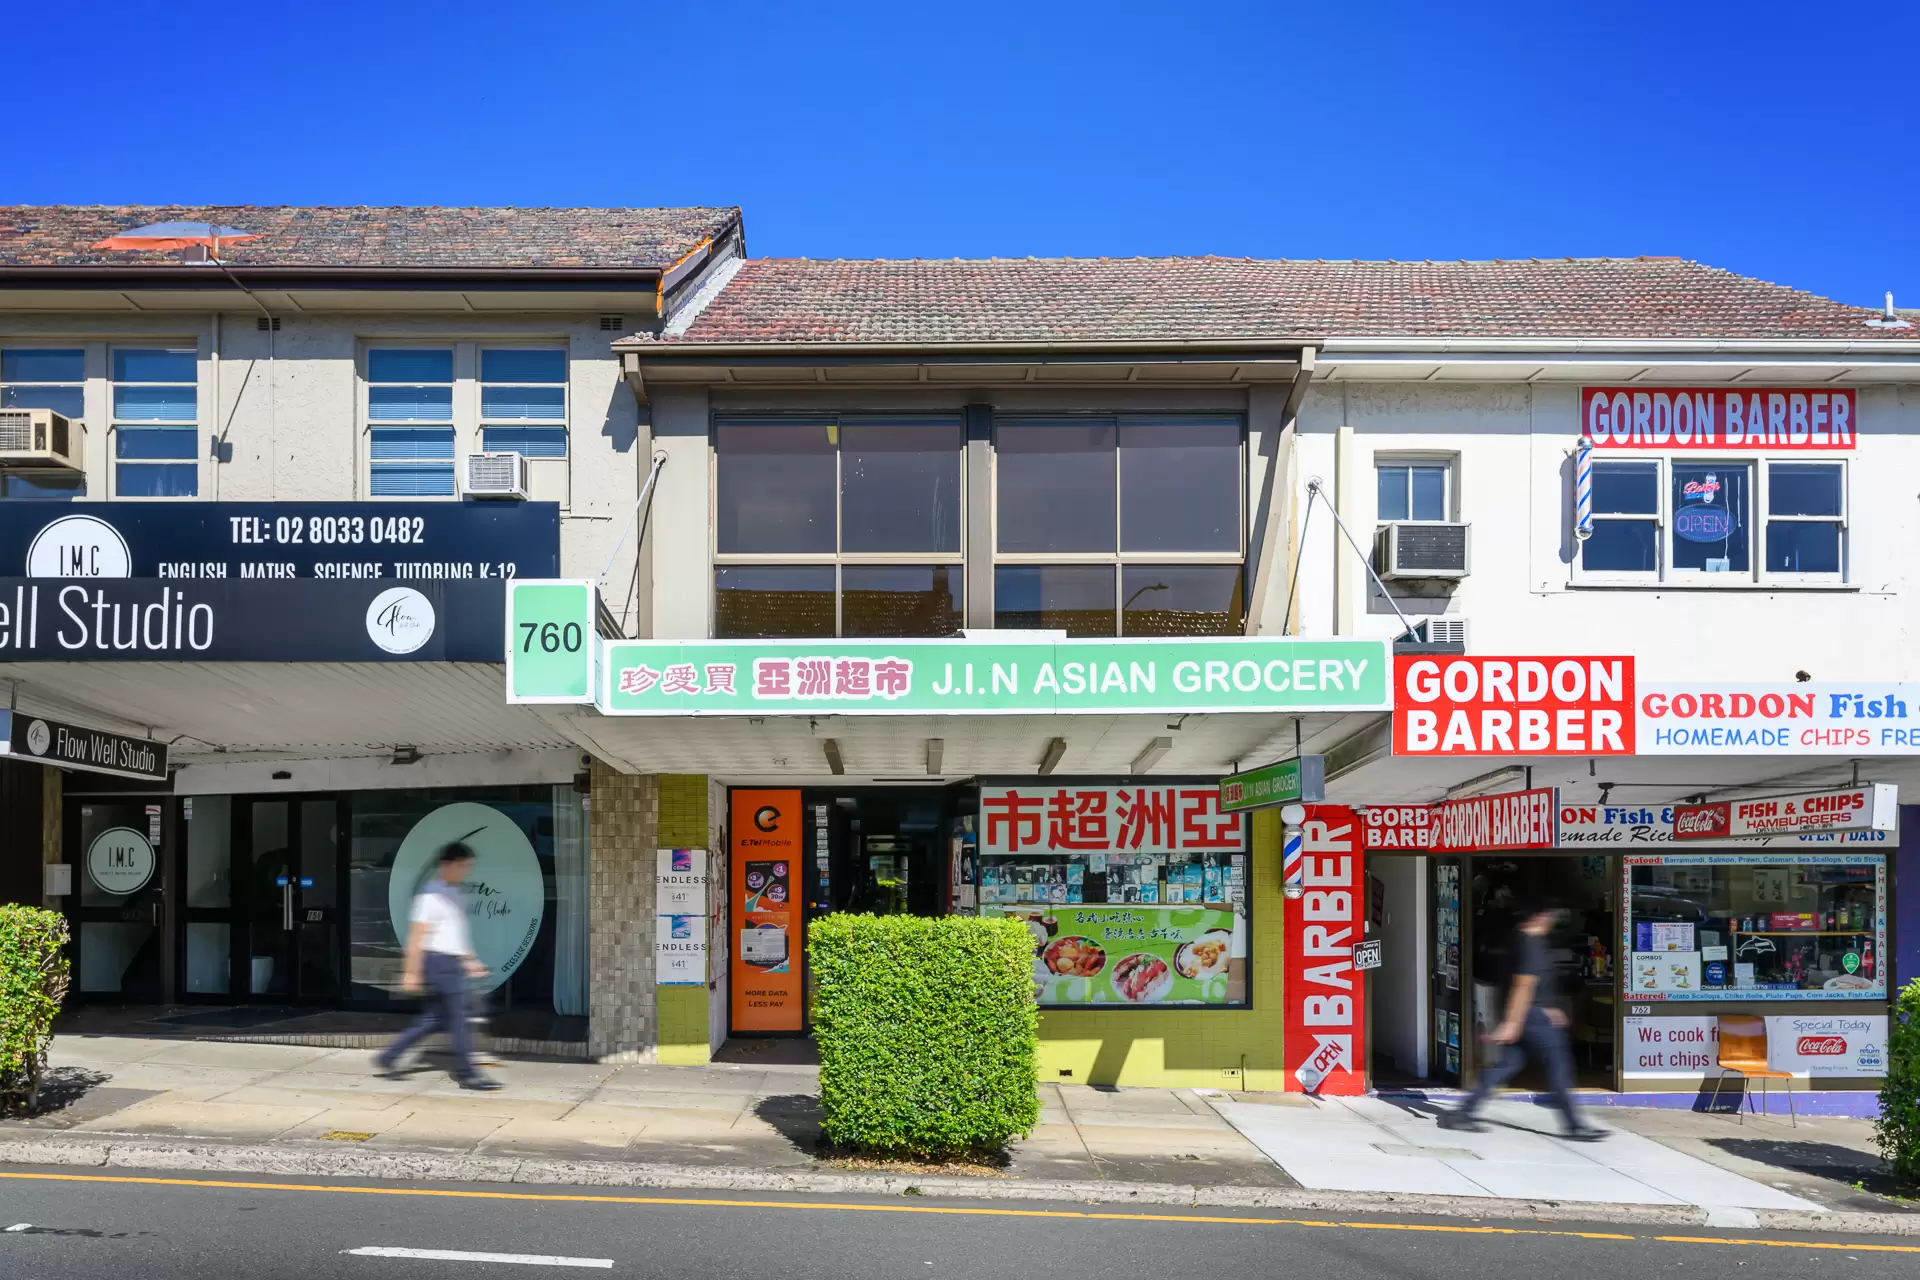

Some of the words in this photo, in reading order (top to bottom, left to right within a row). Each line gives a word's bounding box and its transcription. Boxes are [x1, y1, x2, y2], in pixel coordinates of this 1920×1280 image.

[1589, 391, 1715, 445] GORDON
[1725, 392, 1852, 446] BARBER
[230, 516, 270, 543] TEL:
[276, 516, 303, 544] 02
[309, 516, 364, 544] 8033
[370, 516, 425, 544] 0482
[1677, 515, 1728, 533] OPEN
[158, 562, 227, 578] ENGLISH
[240, 562, 296, 578] MATHS
[314, 562, 383, 578] SCIENCE
[393, 562, 473, 578] TUTORING
[479, 562, 517, 579] K-12
[57, 585, 214, 650] Studio
[519, 622, 582, 653] 760
[756, 660, 910, 696] 亞洲超市
[932, 662, 1018, 695] J.I.N
[1033, 661, 1156, 694] ASIAN
[1172, 658, 1369, 693] GROCERY
[1406, 660, 1623, 703] GORDON
[1641, 693, 1816, 719] GORDON
[1829, 693, 1908, 718] Fish
[1406, 709, 1625, 752] BARBER
[1655, 728, 1790, 746] HOMEMADE
[1800, 727, 1871, 746] CHIPS
[57, 727, 87, 760] Flow
[91, 734, 117, 766] Well
[120, 740, 156, 772] Studio
[1255, 780, 1271, 797] ASIAN
[1272, 773, 1299, 793] GROCERY
[1604, 807, 1655, 825] Fish
[1661, 807, 1674, 825] &
[1738, 802, 1778, 820] FISH
[1784, 802, 1797, 815] &
[1803, 793, 1865, 813] CHIPS
[1443, 801, 1490, 849] GORDON
[1493, 793, 1550, 846] BARBER
[1746, 812, 1852, 829] HAMBURGERS
[109, 846, 135, 867] I.M.C
[1623, 856, 1664, 864] Seafood:
[1303, 819, 1353, 1026] BARBER
[1356, 948, 1379, 965] OPEN
[1623, 992, 1667, 1000] Battered:
[1638, 1027, 1662, 1042] We
[1668, 1027, 1704, 1042] cook
[1792, 1020, 1832, 1034] Special
[1838, 1019, 1872, 1034] Today
[1314, 1040, 1344, 1072] OPEN
[1799, 1038, 1844, 1053] Coca-Cola
[1639, 1052, 1664, 1067] cut
[1669, 1051, 1710, 1070] chips
